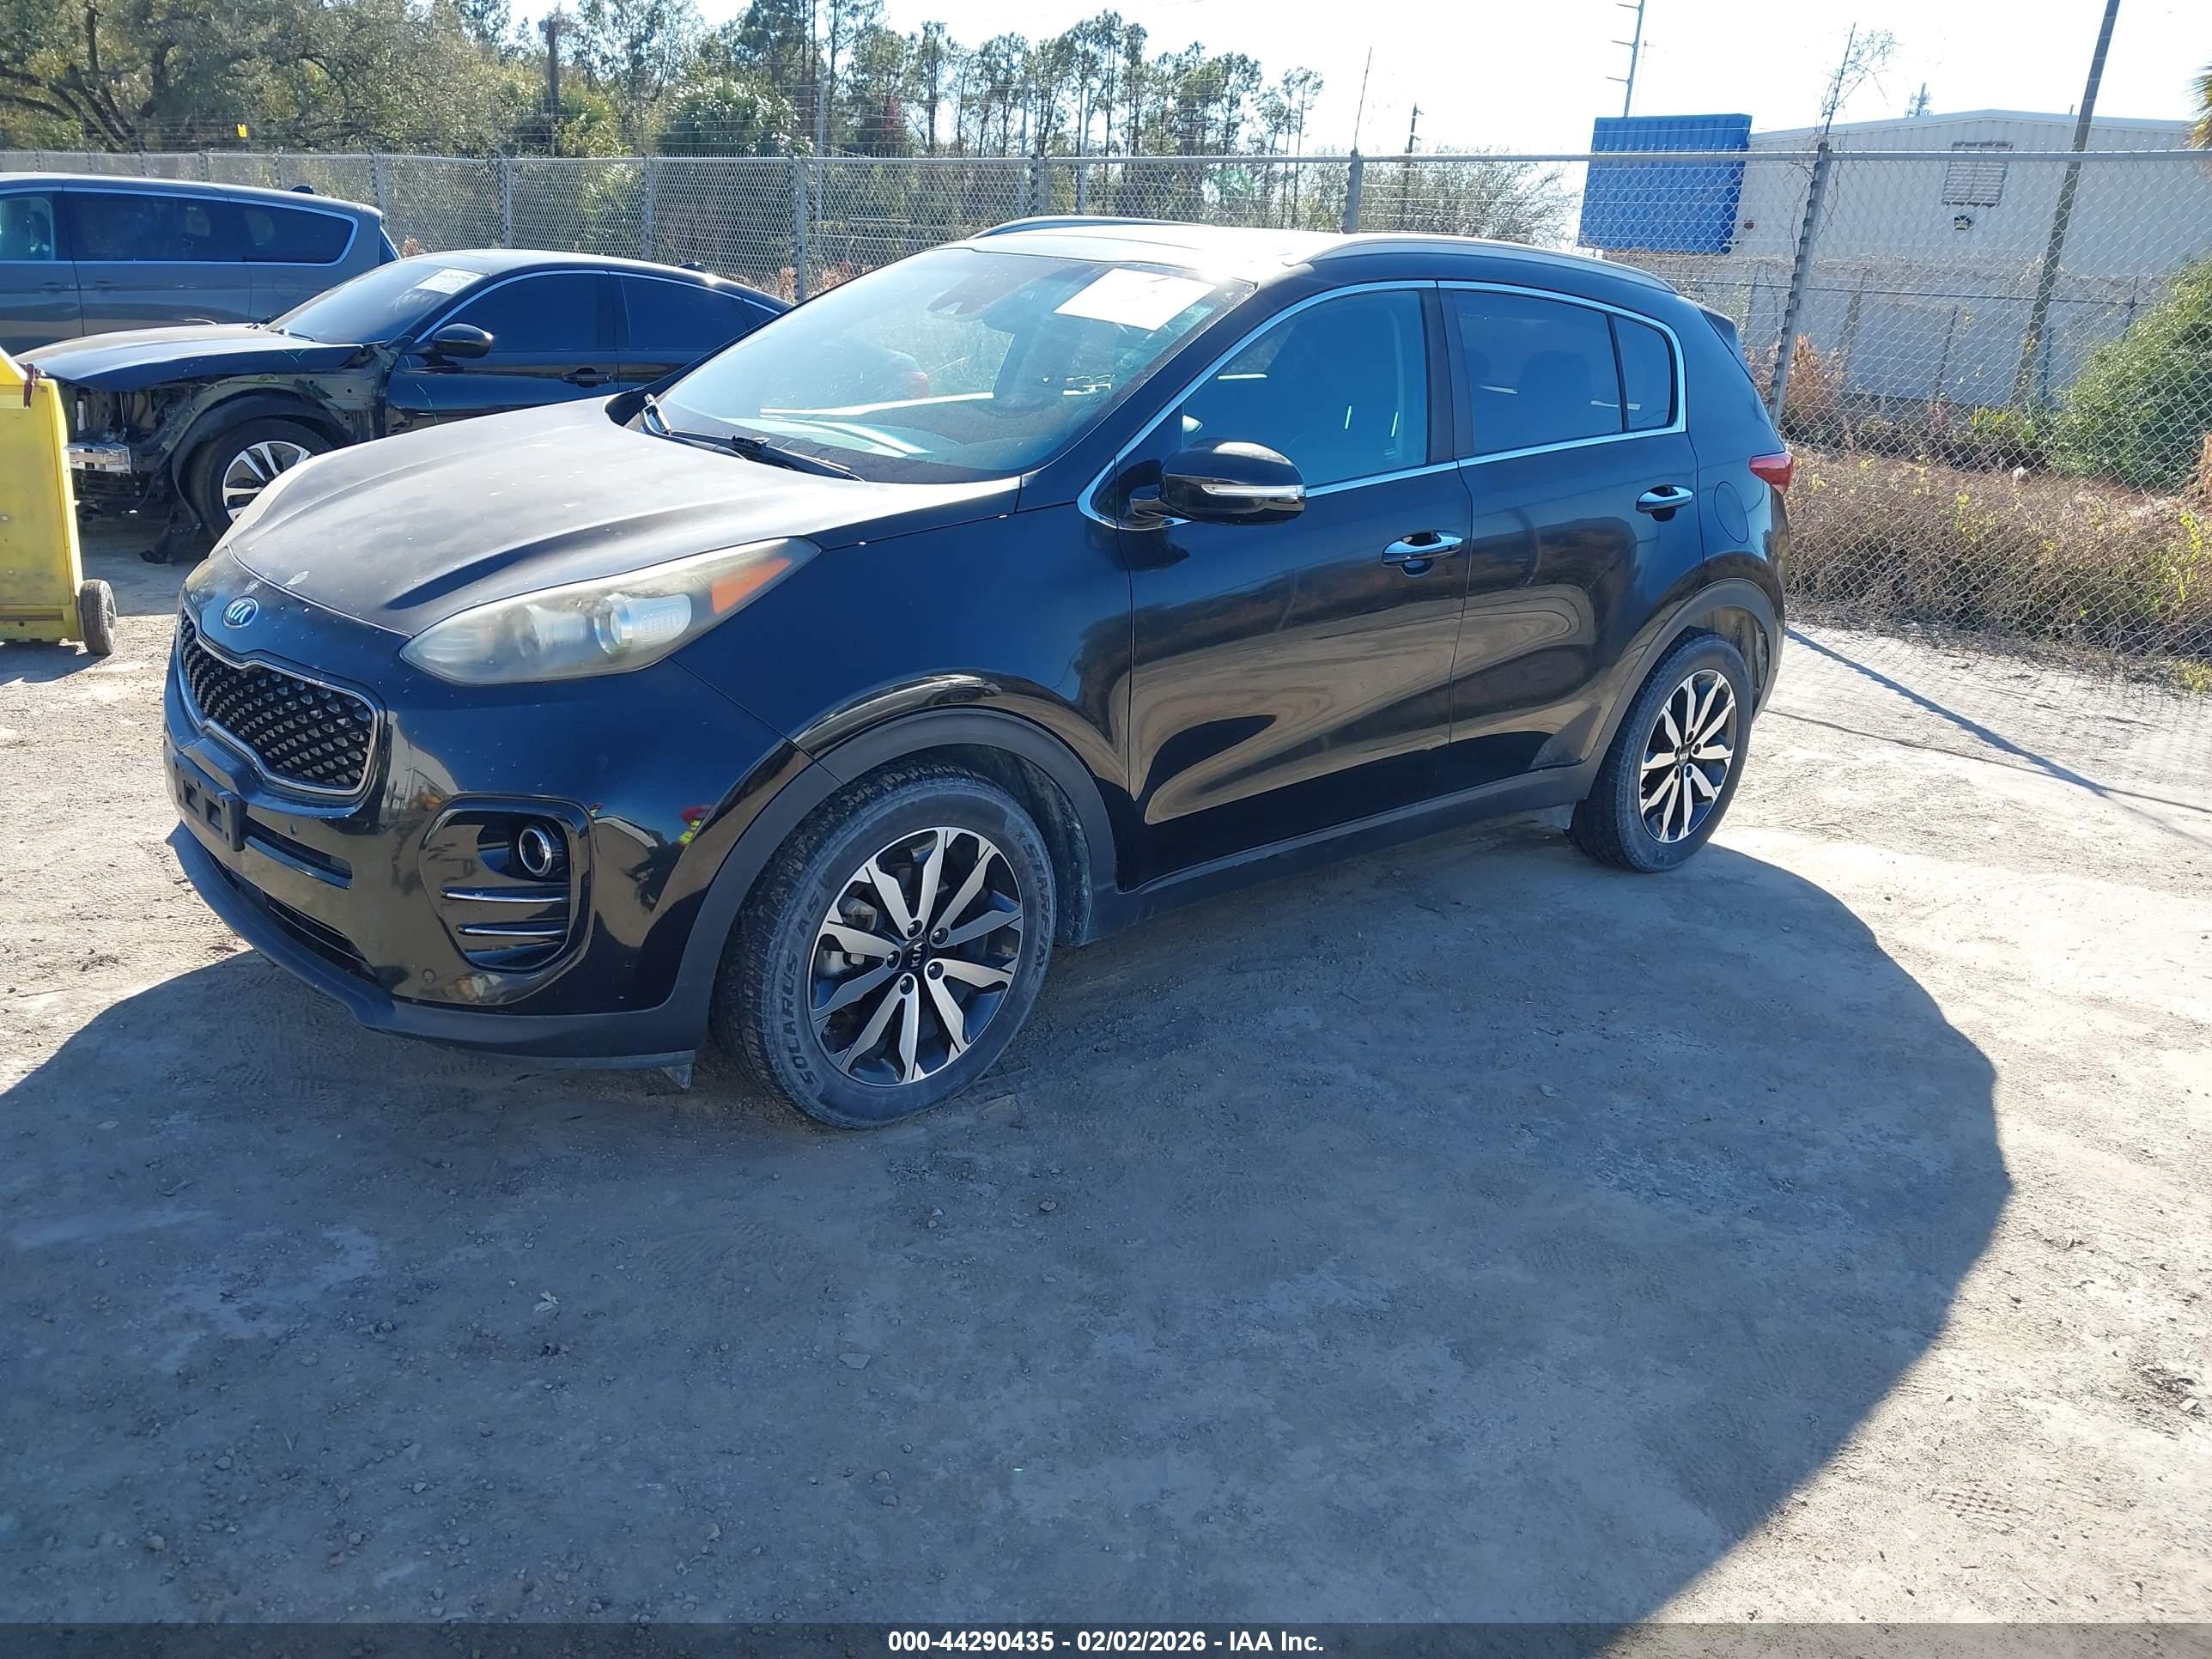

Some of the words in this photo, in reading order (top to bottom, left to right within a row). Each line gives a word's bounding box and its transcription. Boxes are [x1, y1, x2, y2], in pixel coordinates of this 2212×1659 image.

[226, 601, 252, 623] KIA
[910, 942, 923, 967] KIA
[781, 951, 820, 1086] SOLARUS
